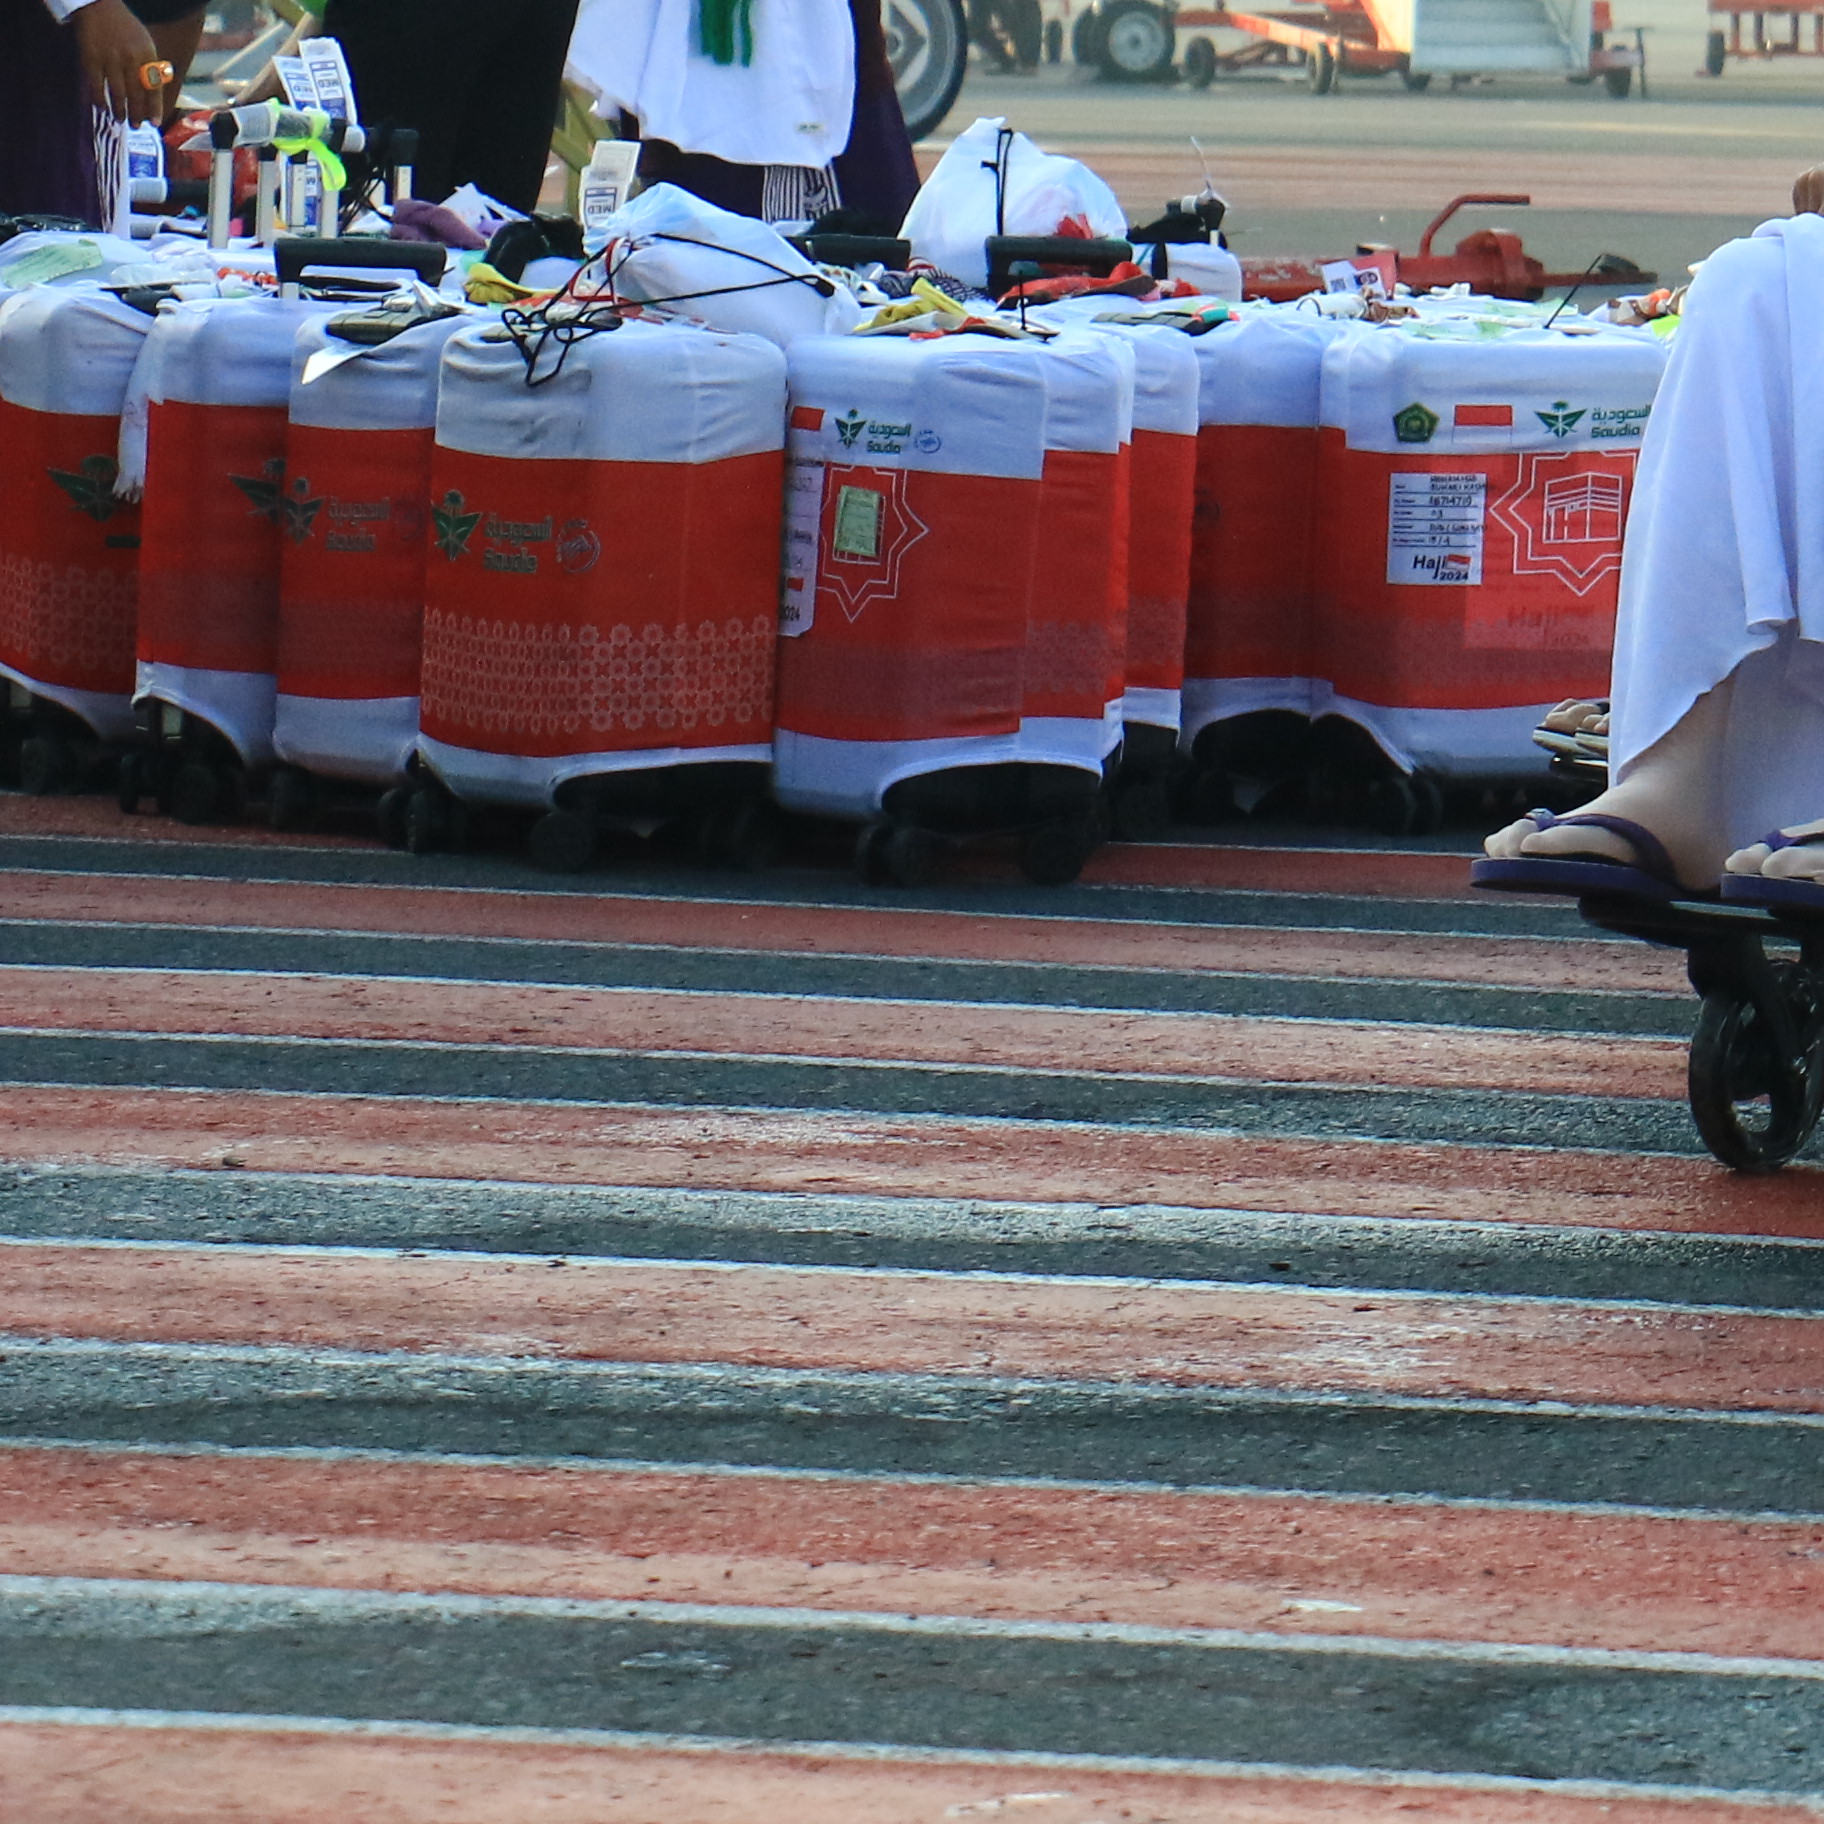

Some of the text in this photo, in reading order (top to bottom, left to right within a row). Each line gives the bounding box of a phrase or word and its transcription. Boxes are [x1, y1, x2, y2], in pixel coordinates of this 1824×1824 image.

[1591, 424, 1640, 439] Saudia
[1413, 554, 1447, 580] Haji
[1440, 571, 1469, 581] 2024
